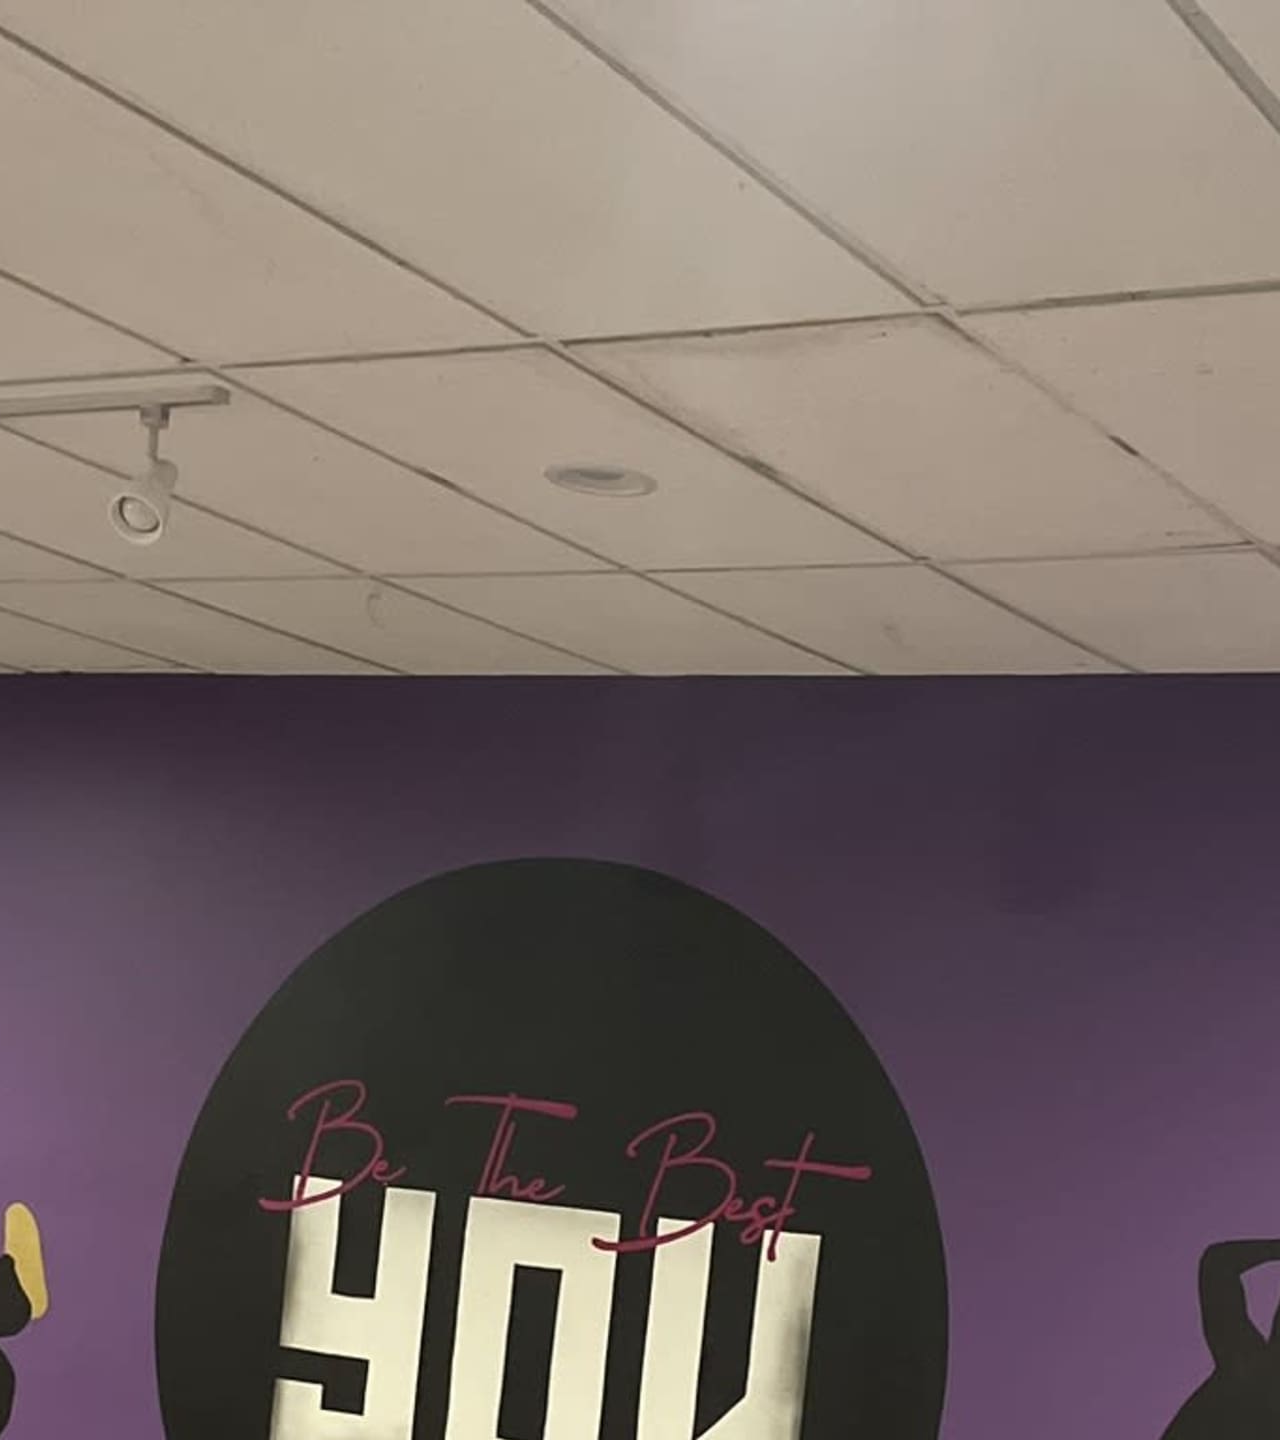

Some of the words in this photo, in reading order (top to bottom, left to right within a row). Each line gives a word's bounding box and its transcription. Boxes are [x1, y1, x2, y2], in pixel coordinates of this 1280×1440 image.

[257, 1079, 408, 1211] Be
[445, 1092, 578, 1201] The
[591, 1111, 872, 1262] Best
